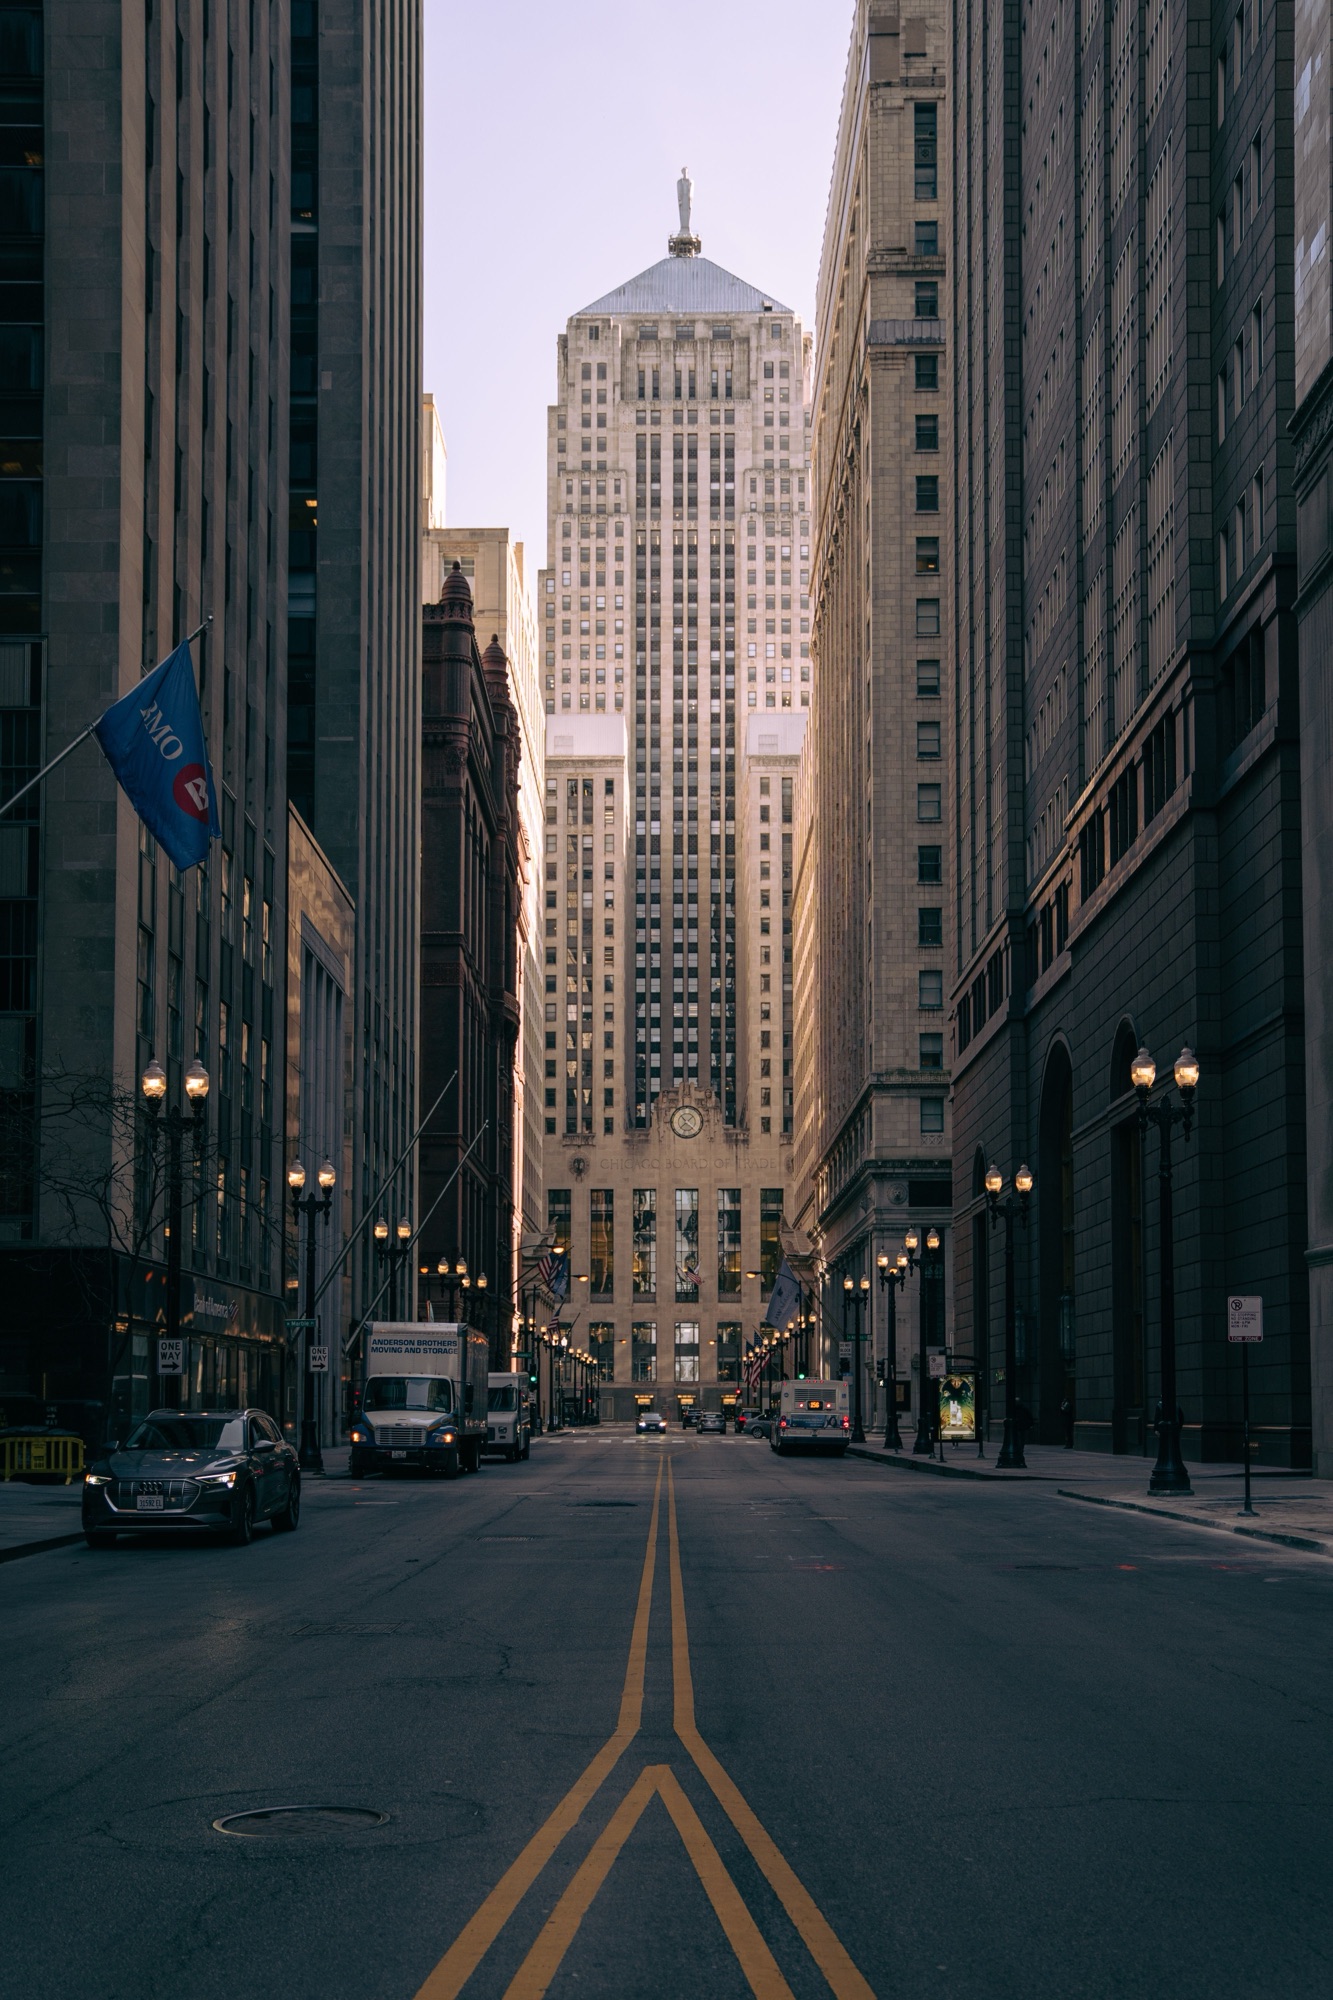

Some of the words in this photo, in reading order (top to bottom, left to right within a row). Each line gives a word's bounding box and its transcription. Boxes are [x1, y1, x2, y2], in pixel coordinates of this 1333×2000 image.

[600, 1158, 660, 1169] CHICAGO
[665, 1158, 708, 1169] BOARD
[714, 1158, 731, 1169] OF
[736, 1158, 777, 1169] TRADE
[193, 1293, 206, 1313] Bank
[211, 1298, 229, 1318] America
[161, 1342, 181, 1350] ONE
[417, 1339, 457, 1347] BROTHERS
[161, 1352, 181, 1360] WAY
